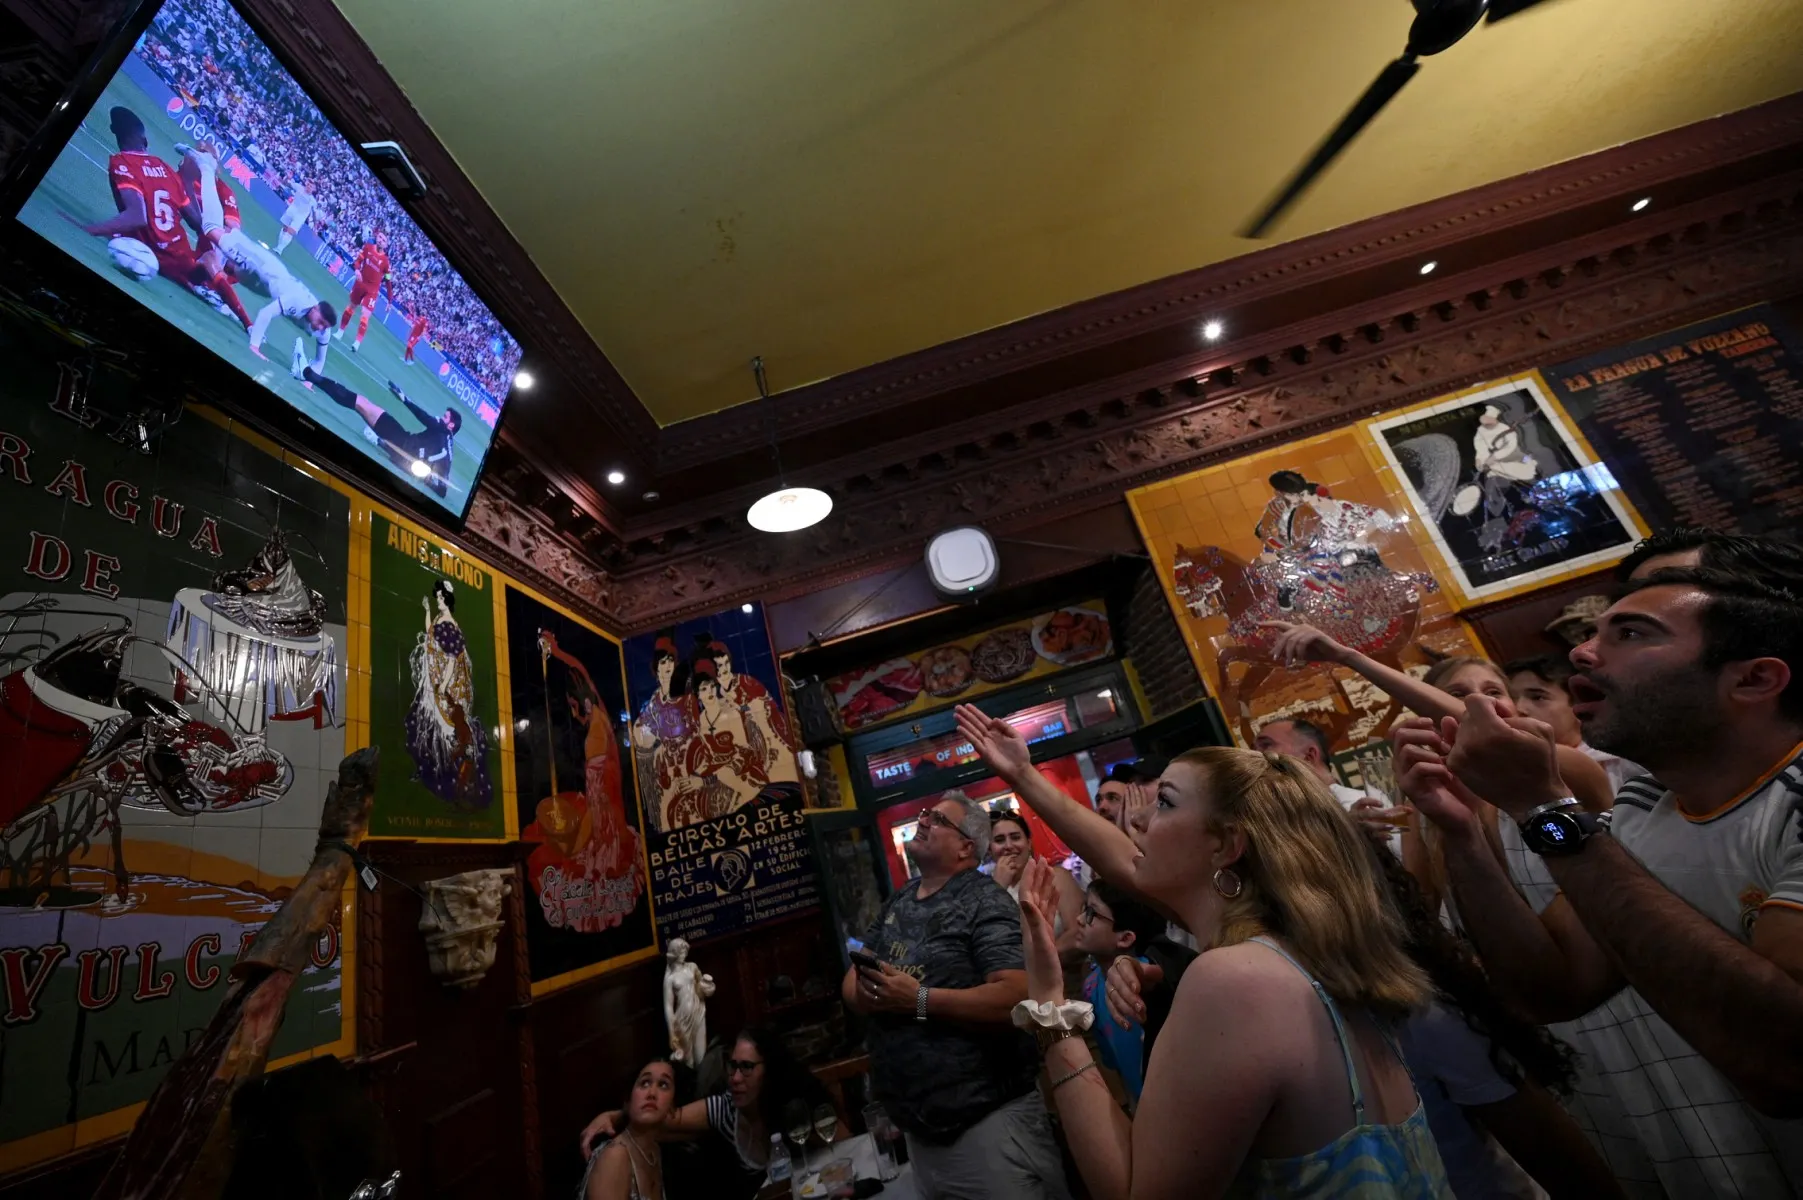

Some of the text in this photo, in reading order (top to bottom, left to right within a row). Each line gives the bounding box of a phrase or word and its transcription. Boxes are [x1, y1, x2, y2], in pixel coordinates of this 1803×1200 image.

[154, 189, 175, 232] 5
[448, 372, 480, 412] pepsi
[22, 531, 121, 600] DE
[387, 522, 429, 564] ANIS
[441, 549, 484, 591] MONO
[1043, 720, 1064, 735] BAR
[876, 761, 912, 780] TASTE
[936, 749, 951, 762] OF
[650, 811, 805, 867] BELLAS ARTES
[667, 803, 784, 847] CIRCVLO DE
[751, 840, 762, 852] 12
[768, 841, 796, 856] 1945
[654, 856, 707, 881] BAILE
[766, 855, 777, 867] SU
[770, 860, 802, 877] SOCIAL
[655, 880, 715, 907] TRAJES
[671, 873, 695, 889] DE
[0, 922, 340, 1024] VULCO
